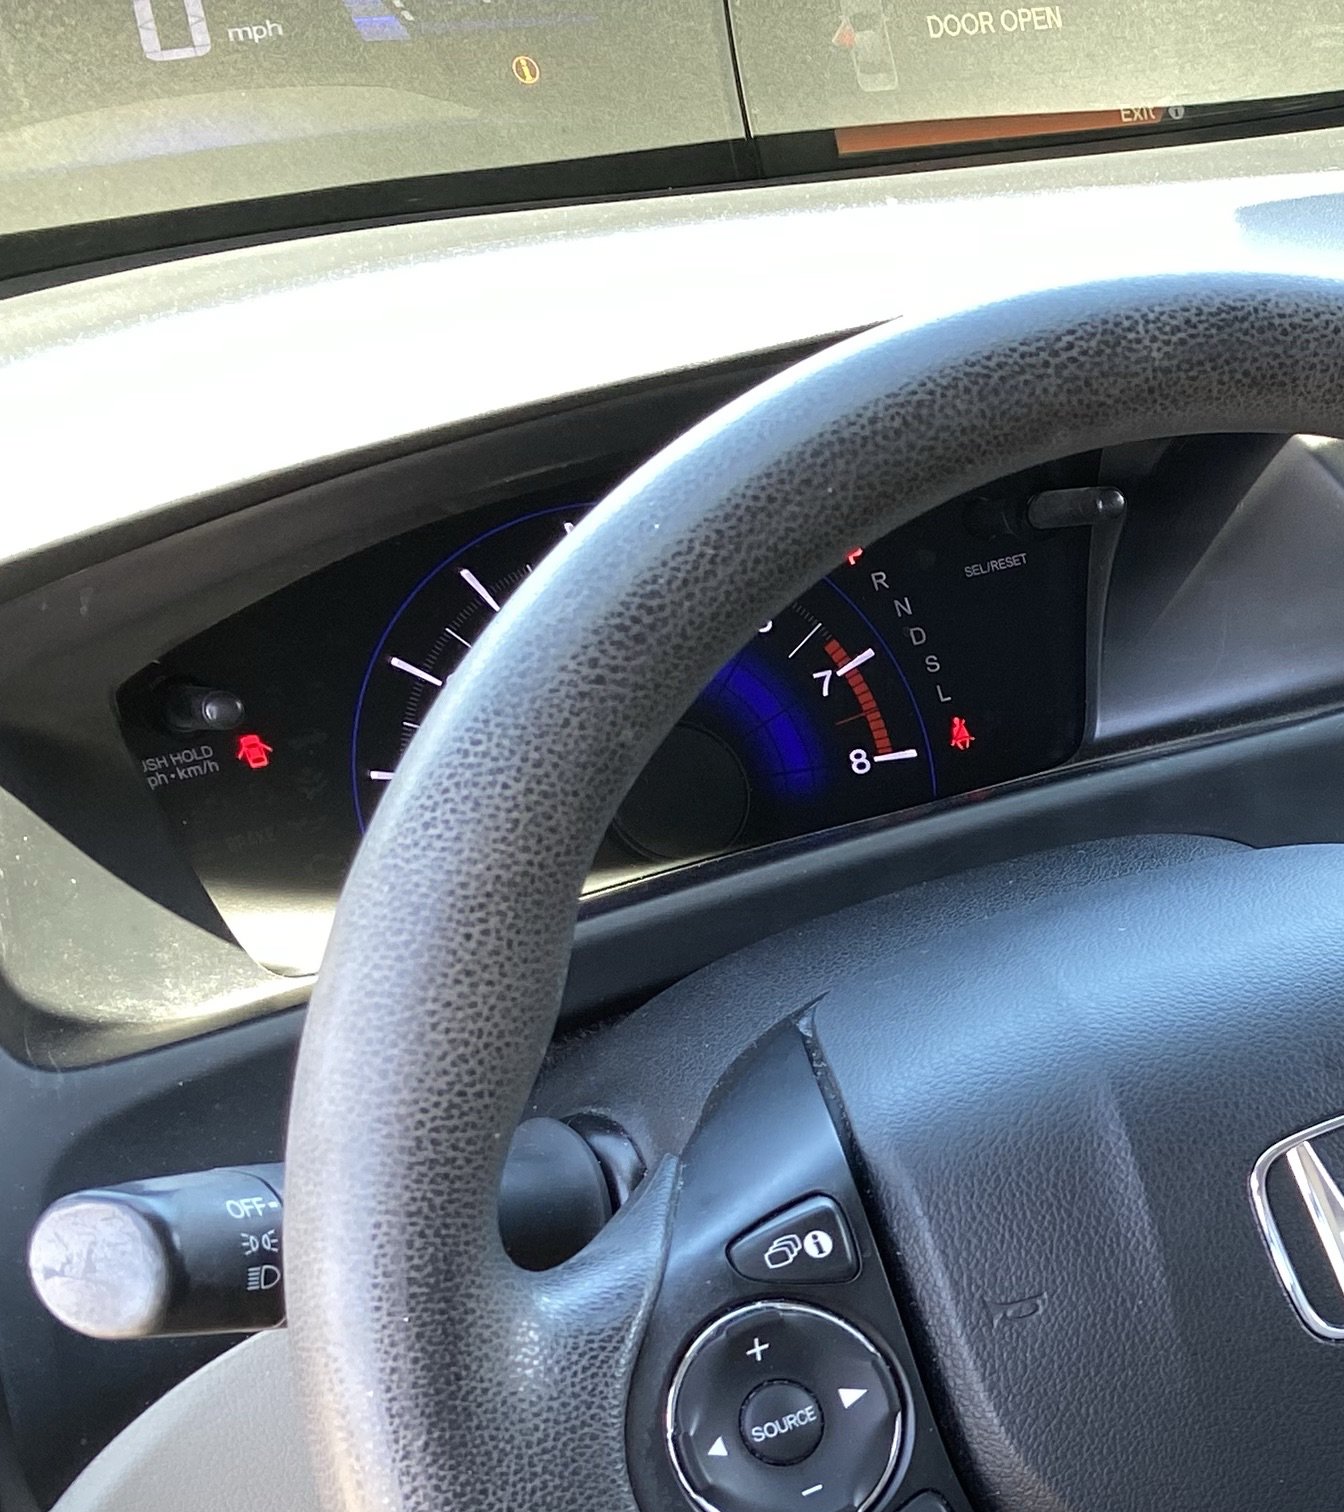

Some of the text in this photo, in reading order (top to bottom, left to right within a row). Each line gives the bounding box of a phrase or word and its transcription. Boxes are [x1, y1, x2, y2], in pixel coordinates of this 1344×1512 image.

[227, 20, 283, 44] mph
[926, 6, 1063, 38] DOOR OPEN
[964, 552, 1028, 578] SEL/RESET
[870, 571, 952, 703] R N D S L
[812, 669, 833, 696] 7
[170, 745, 213, 765] HOLD
[849, 748, 872, 774] 8
[226, 1197, 266, 1219] OFF
[751, 1405, 818, 1444] SOURCE
